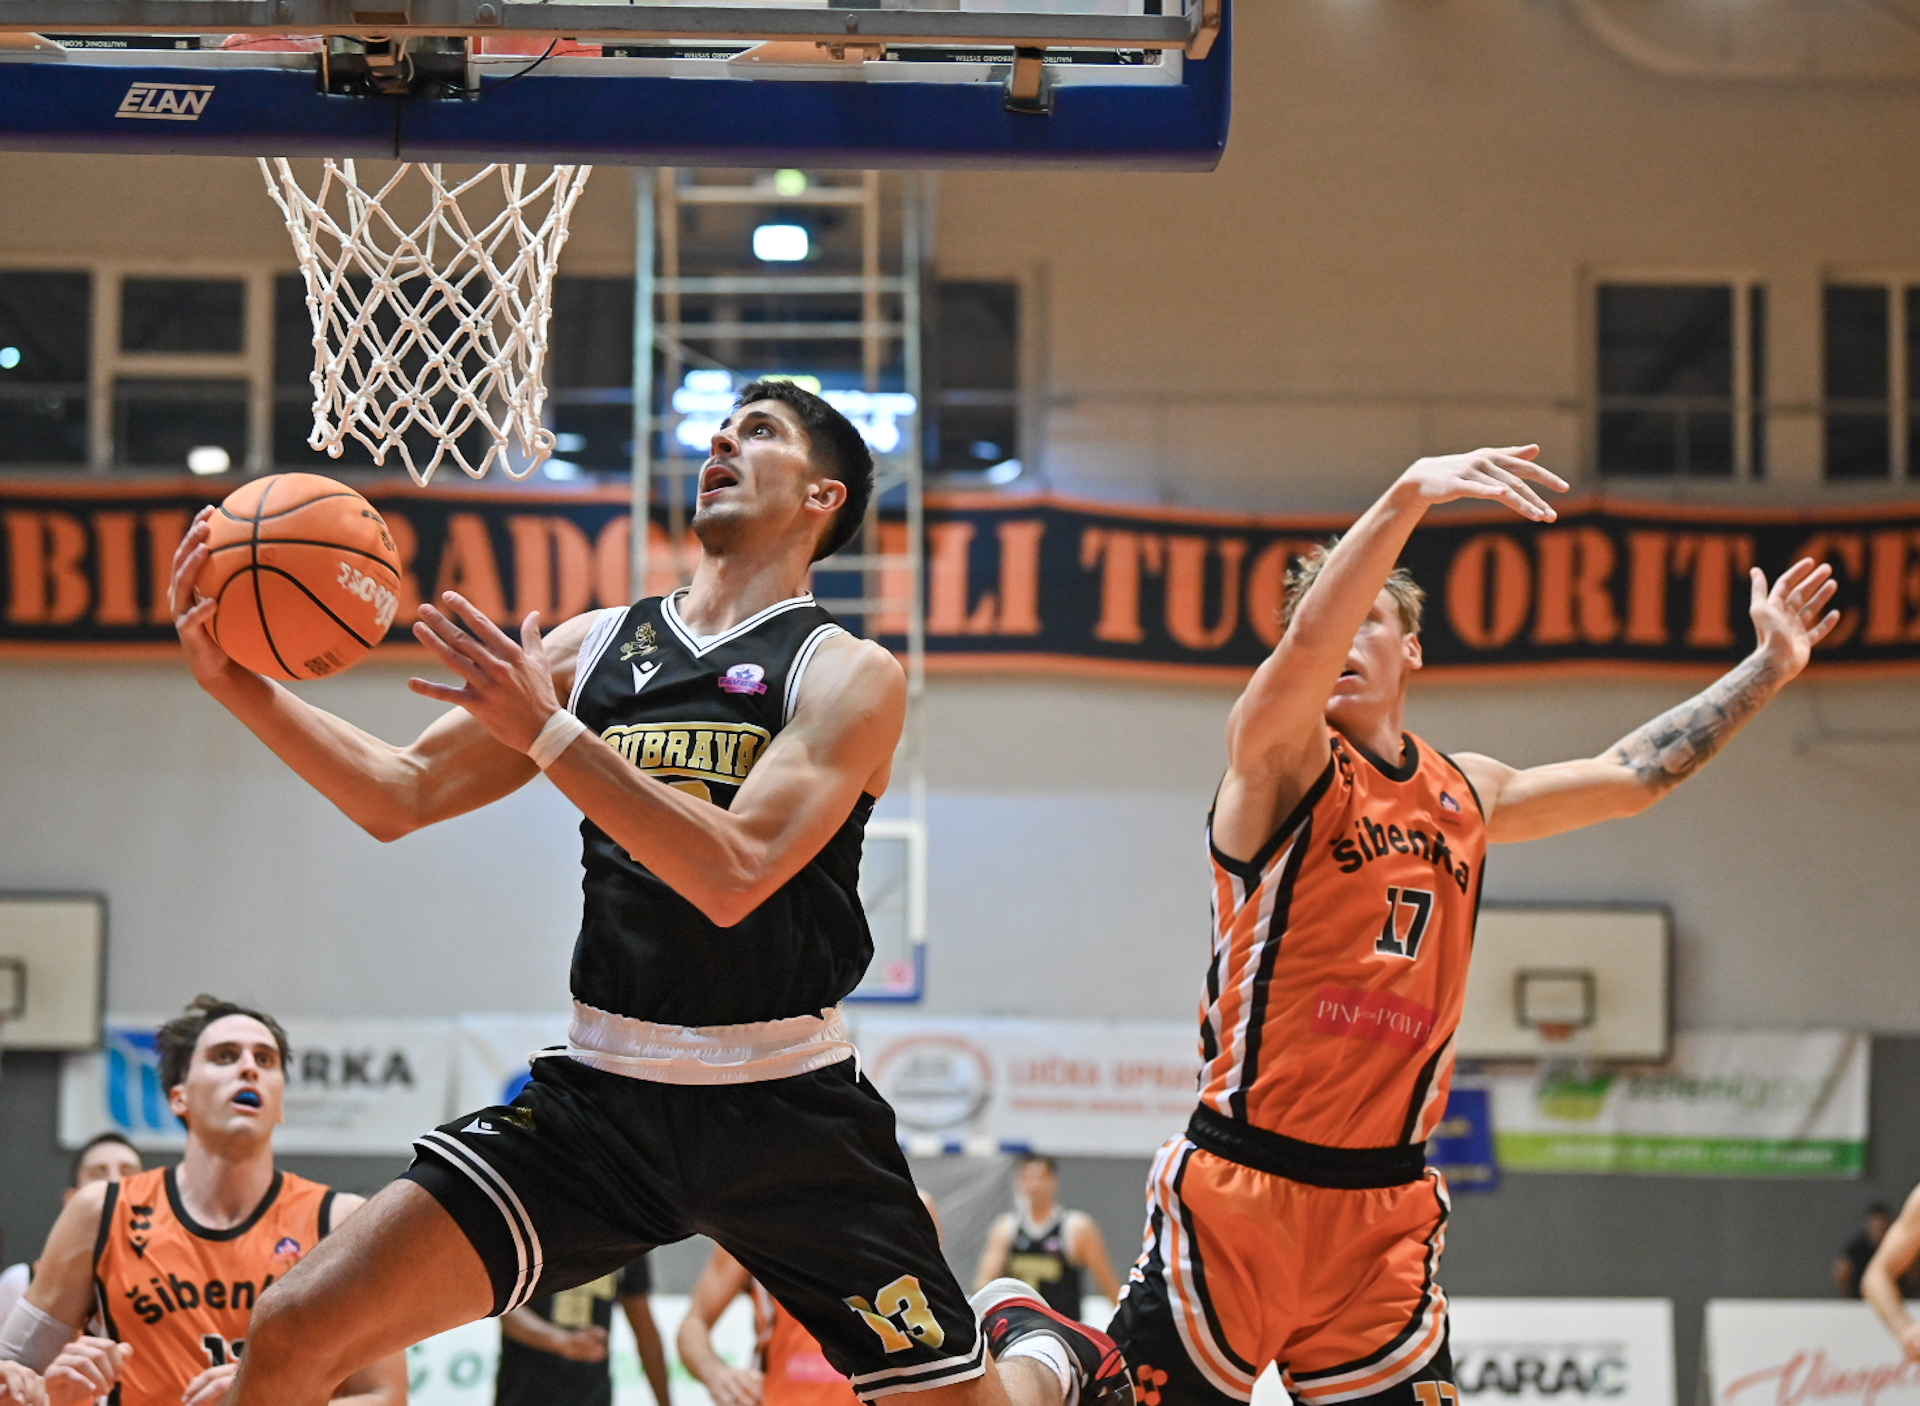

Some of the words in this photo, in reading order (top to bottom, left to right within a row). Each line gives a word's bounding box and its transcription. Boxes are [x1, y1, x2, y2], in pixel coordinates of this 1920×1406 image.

[84, 39, 127, 47] NAUTRONIC
[117, 87, 213, 115] ELAN
[1446, 526, 1756, 649] ORIT
[1374, 885, 1434, 961] 17
[842, 1274, 945, 1354] 13
